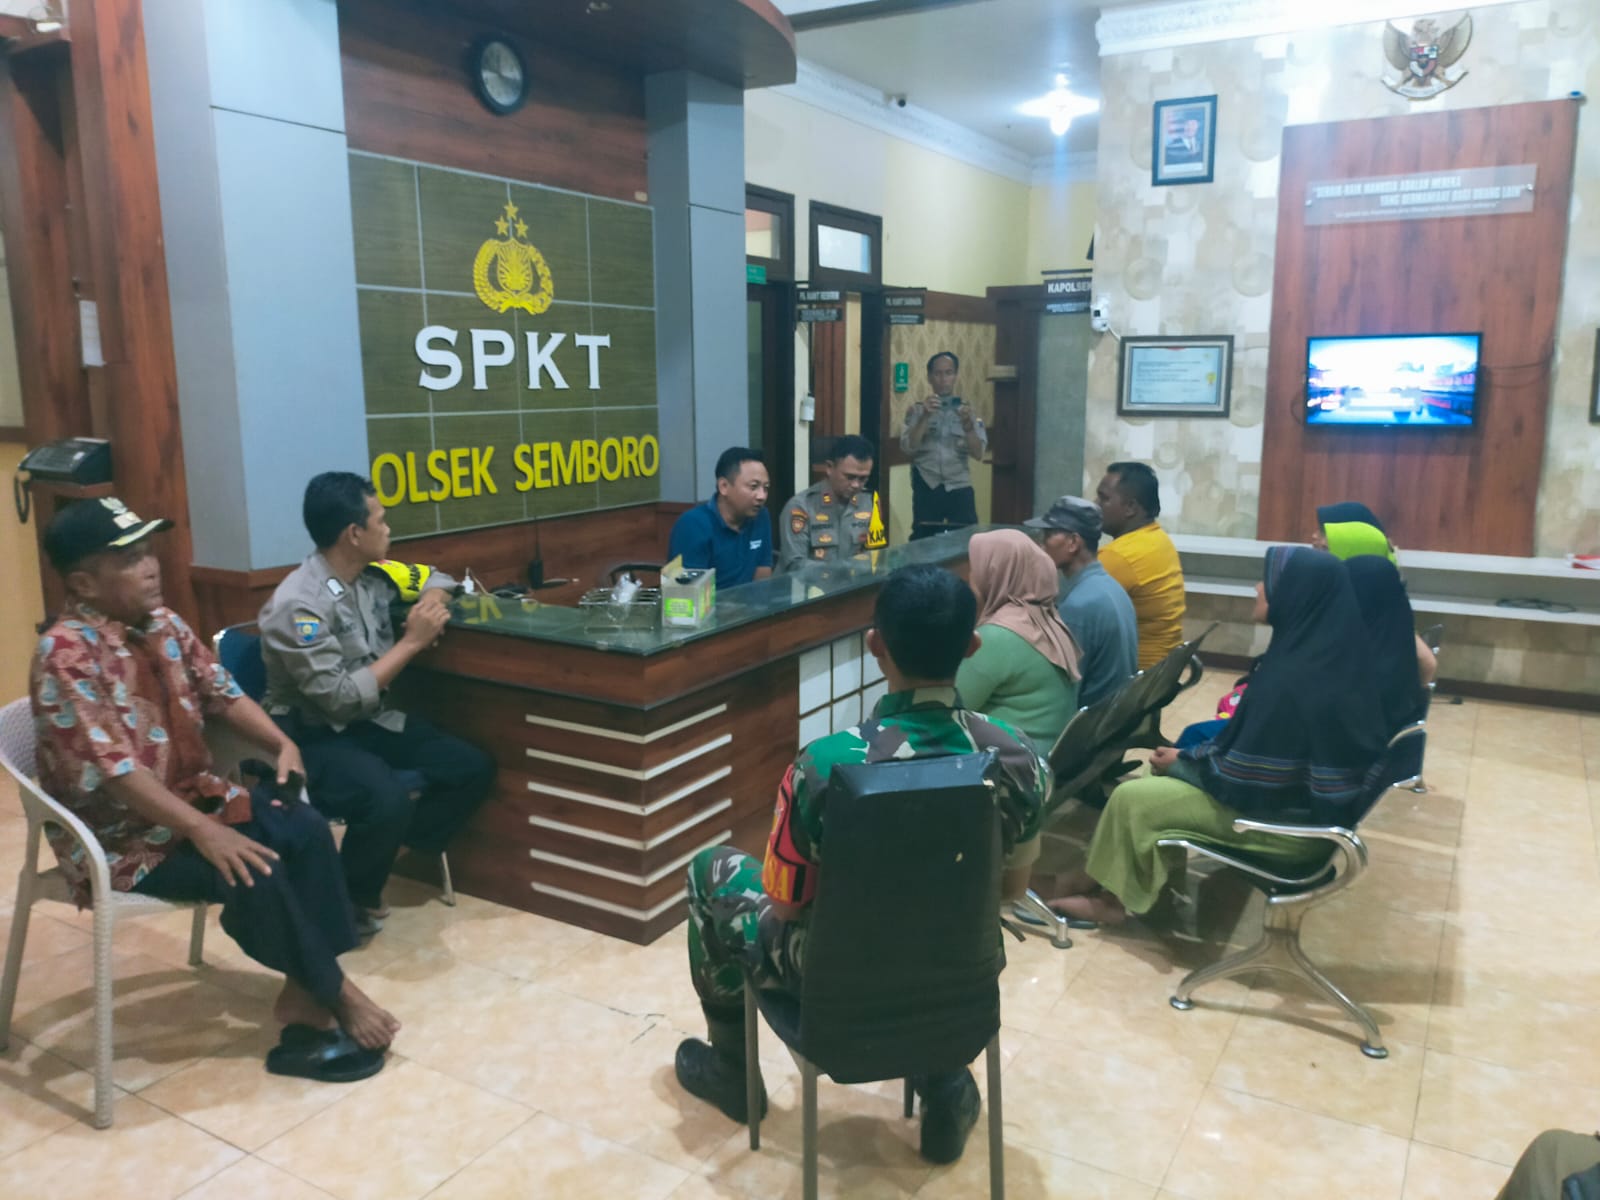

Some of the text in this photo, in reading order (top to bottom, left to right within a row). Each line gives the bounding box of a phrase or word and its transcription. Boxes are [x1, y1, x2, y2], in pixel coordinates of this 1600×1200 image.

[414, 325, 611, 391] SPKT
[371, 434, 660, 507] OLSEK SEMBORO
